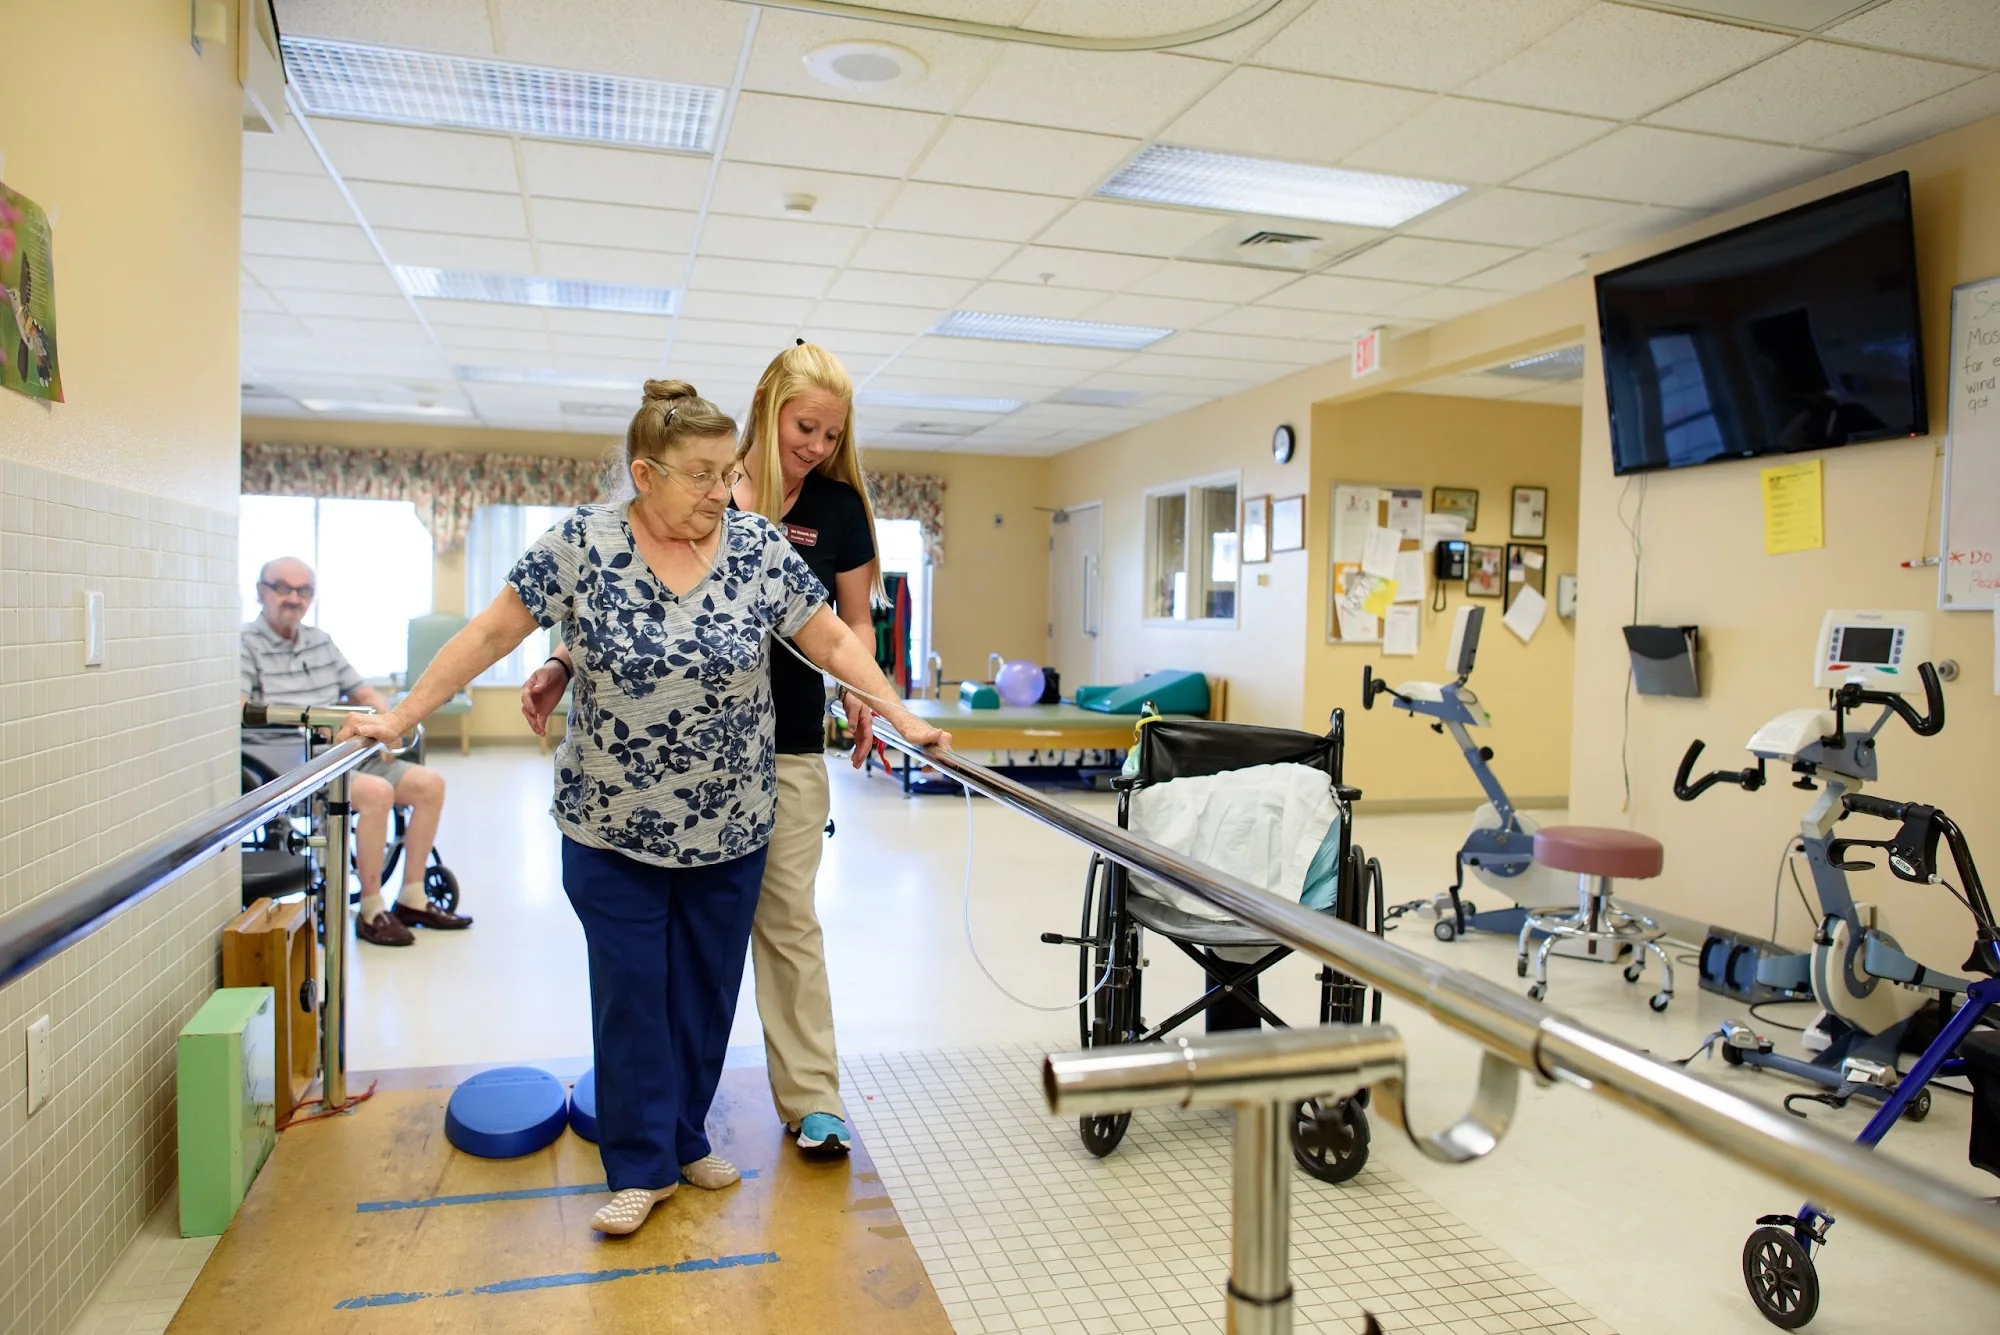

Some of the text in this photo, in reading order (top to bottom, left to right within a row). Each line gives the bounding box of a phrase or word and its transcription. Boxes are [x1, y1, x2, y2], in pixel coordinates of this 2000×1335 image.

[1965, 375, 1996, 394] wind
[1969, 550, 1992, 564] Do
[1895, 859, 1911, 872] drive
